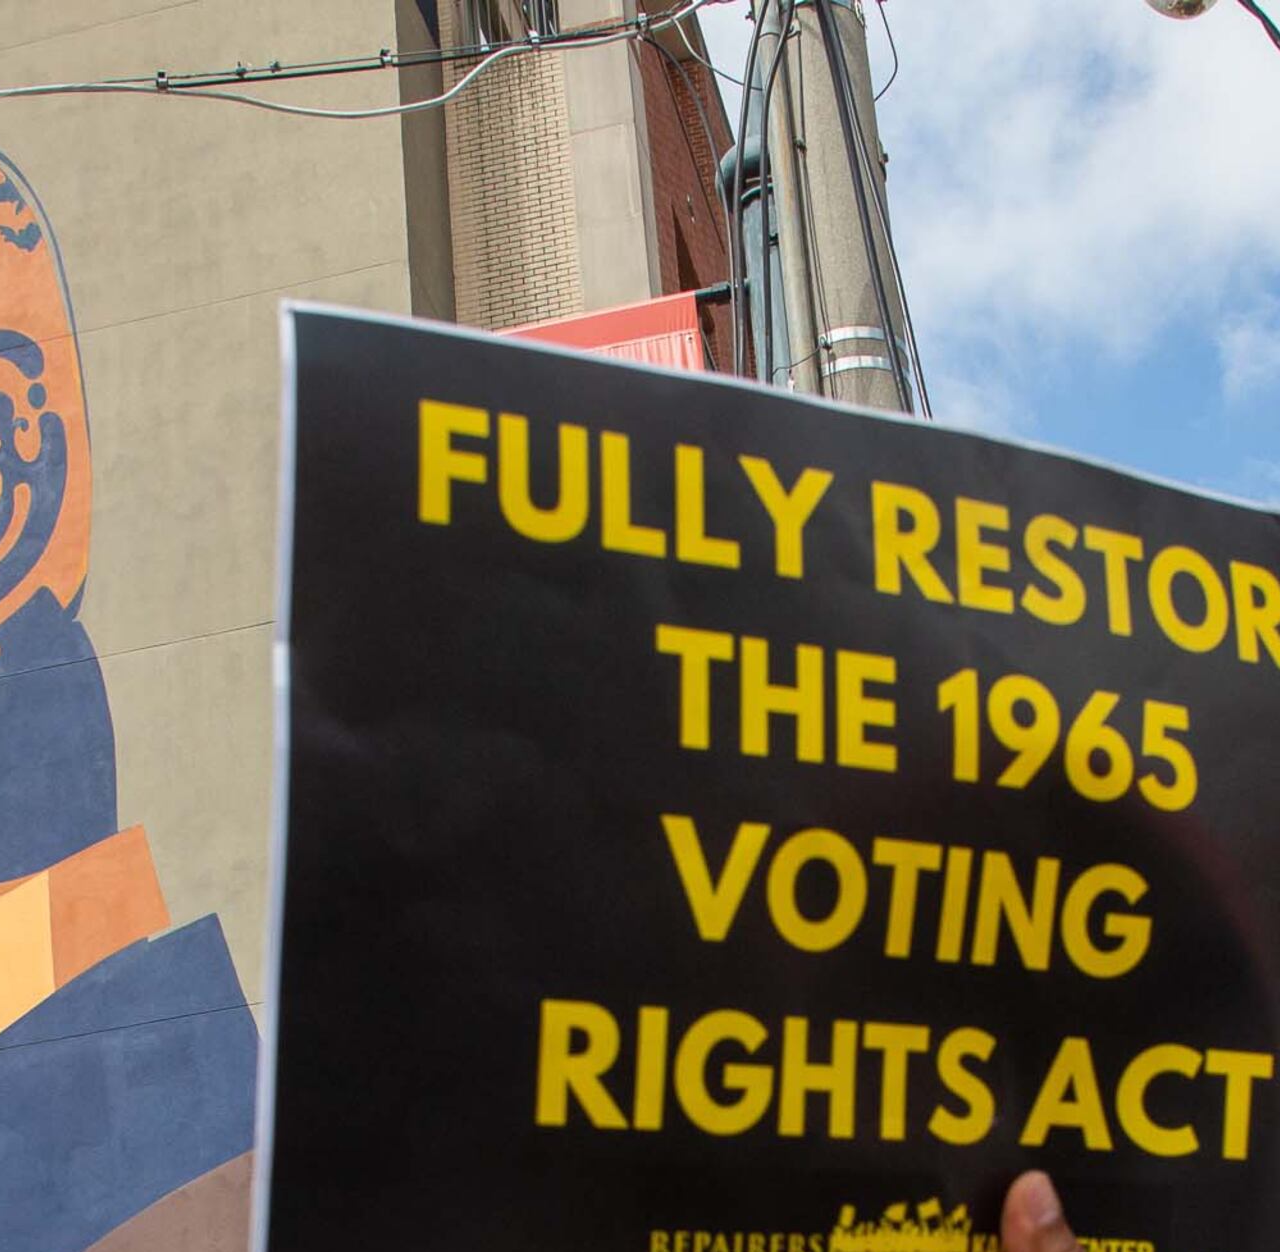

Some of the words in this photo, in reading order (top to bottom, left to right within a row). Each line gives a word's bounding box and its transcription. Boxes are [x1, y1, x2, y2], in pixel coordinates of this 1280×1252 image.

[419, 400, 832, 578] FULLY
[656, 624, 897, 772] THE
[937, 669, 1197, 811] 1965
[662, 815, 1151, 978] VOTING
[536, 1000, 995, 1145] RIGHTS
[1020, 1038, 1274, 1160] ACT
